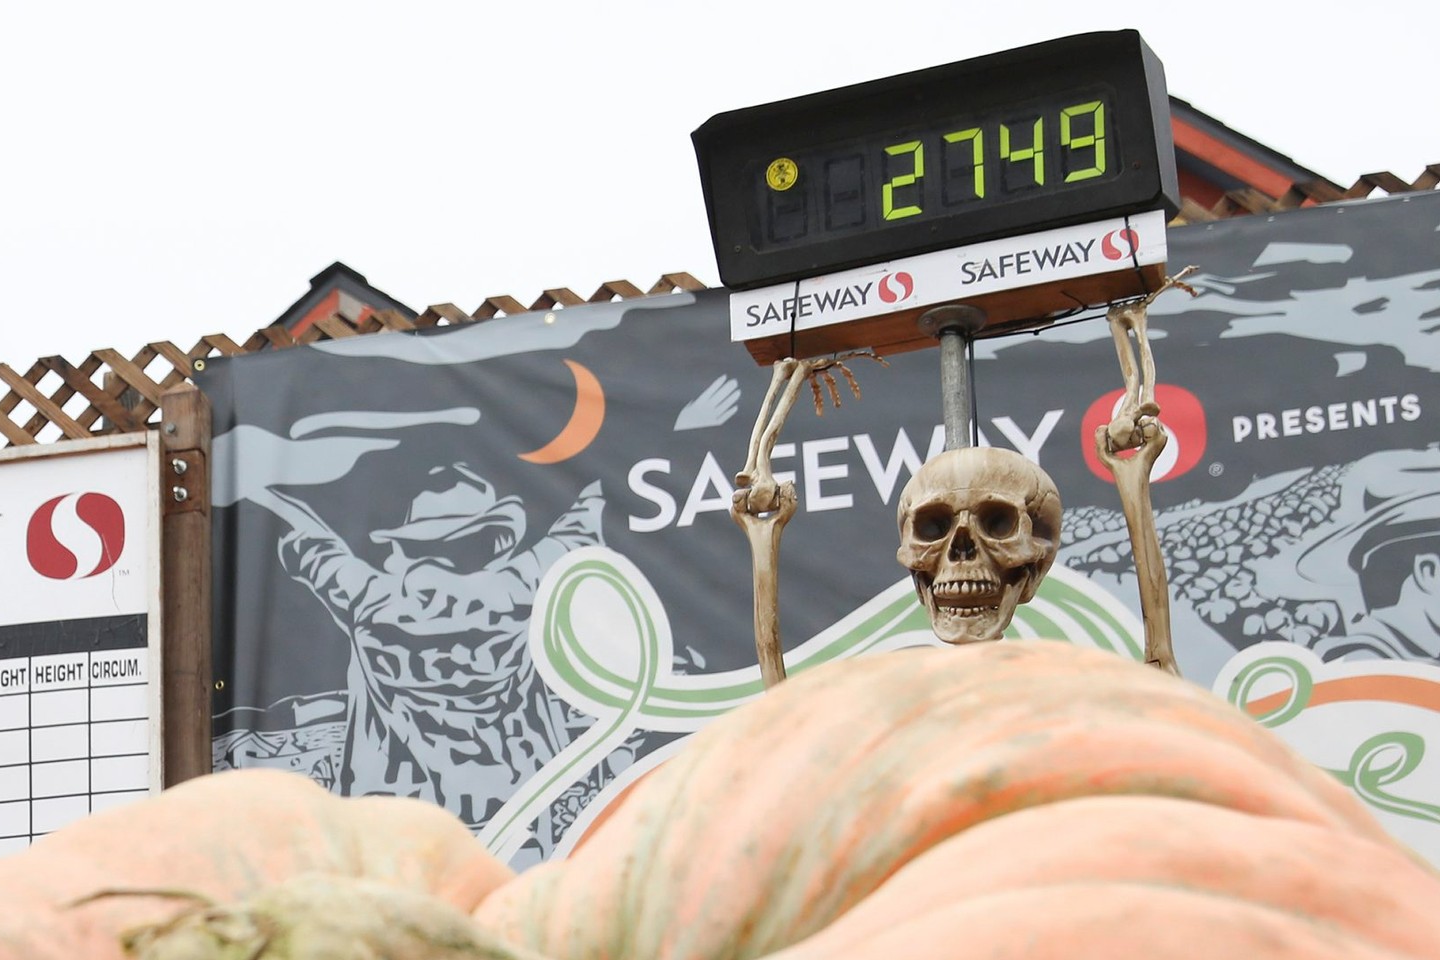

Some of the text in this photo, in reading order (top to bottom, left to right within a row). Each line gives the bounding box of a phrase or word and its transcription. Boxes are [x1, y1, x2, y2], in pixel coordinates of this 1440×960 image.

[882, 100, 1106, 221] 2749
[960, 238, 1096, 285] SAFEWAY
[746, 281, 873, 327] SAFEWAY
[1232, 394, 1421, 443] PRESENTS
[628, 409, 1064, 533] SAEWY
[35, 663, 84, 684] HEIGHT
[91, 658, 142, 680] CIRCUM.
